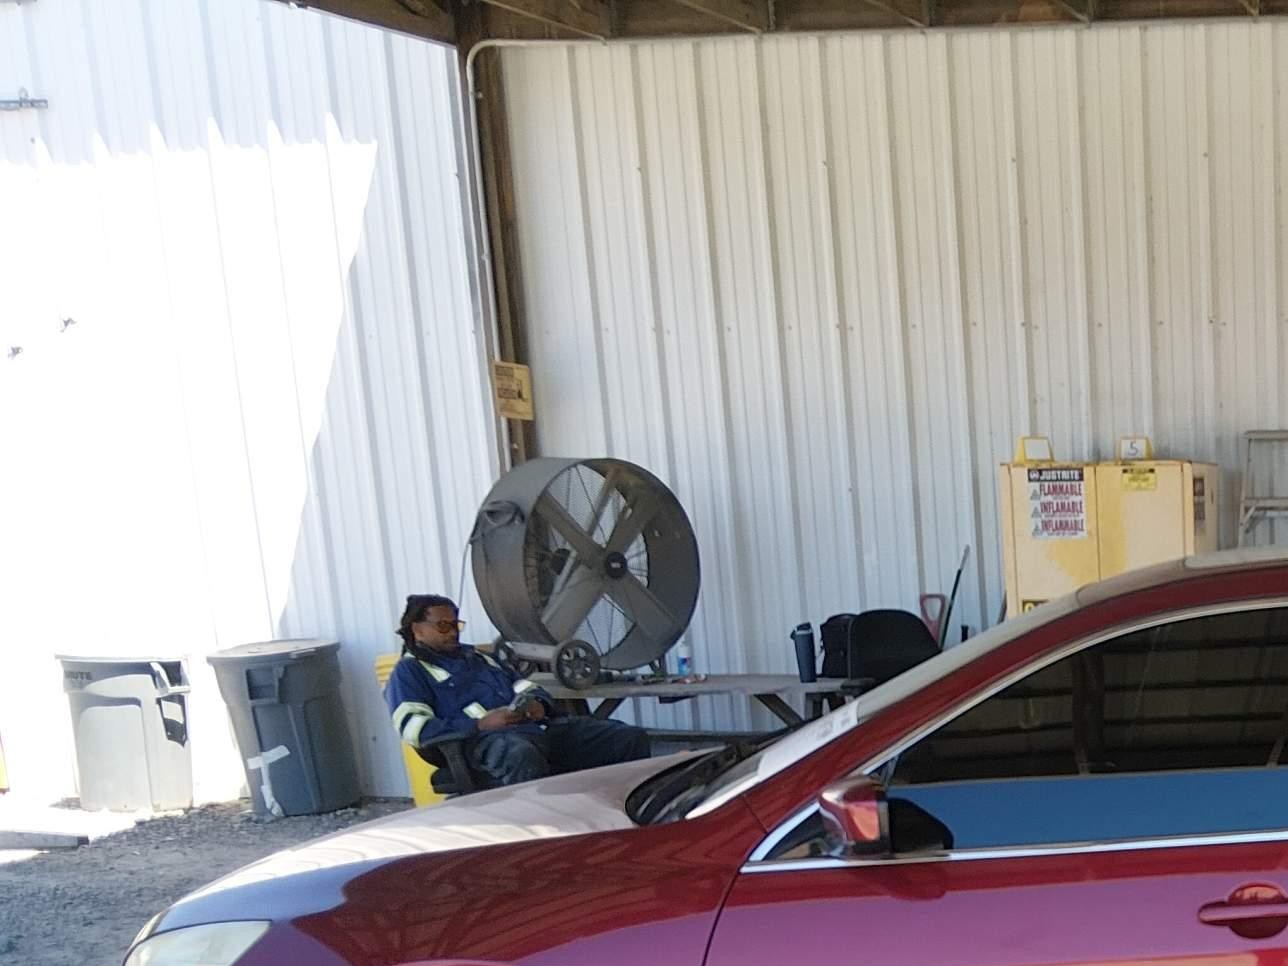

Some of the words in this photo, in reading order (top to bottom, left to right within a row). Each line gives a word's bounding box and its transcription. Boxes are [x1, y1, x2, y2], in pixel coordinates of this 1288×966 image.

[1039, 469, 1081, 480] JUSTRITE
[1039, 483, 1082, 496] FLAMMABLE
[1040, 500, 1084, 513] INFLAMABLE
[1041, 518, 1085, 531] INFLAMMABLE
